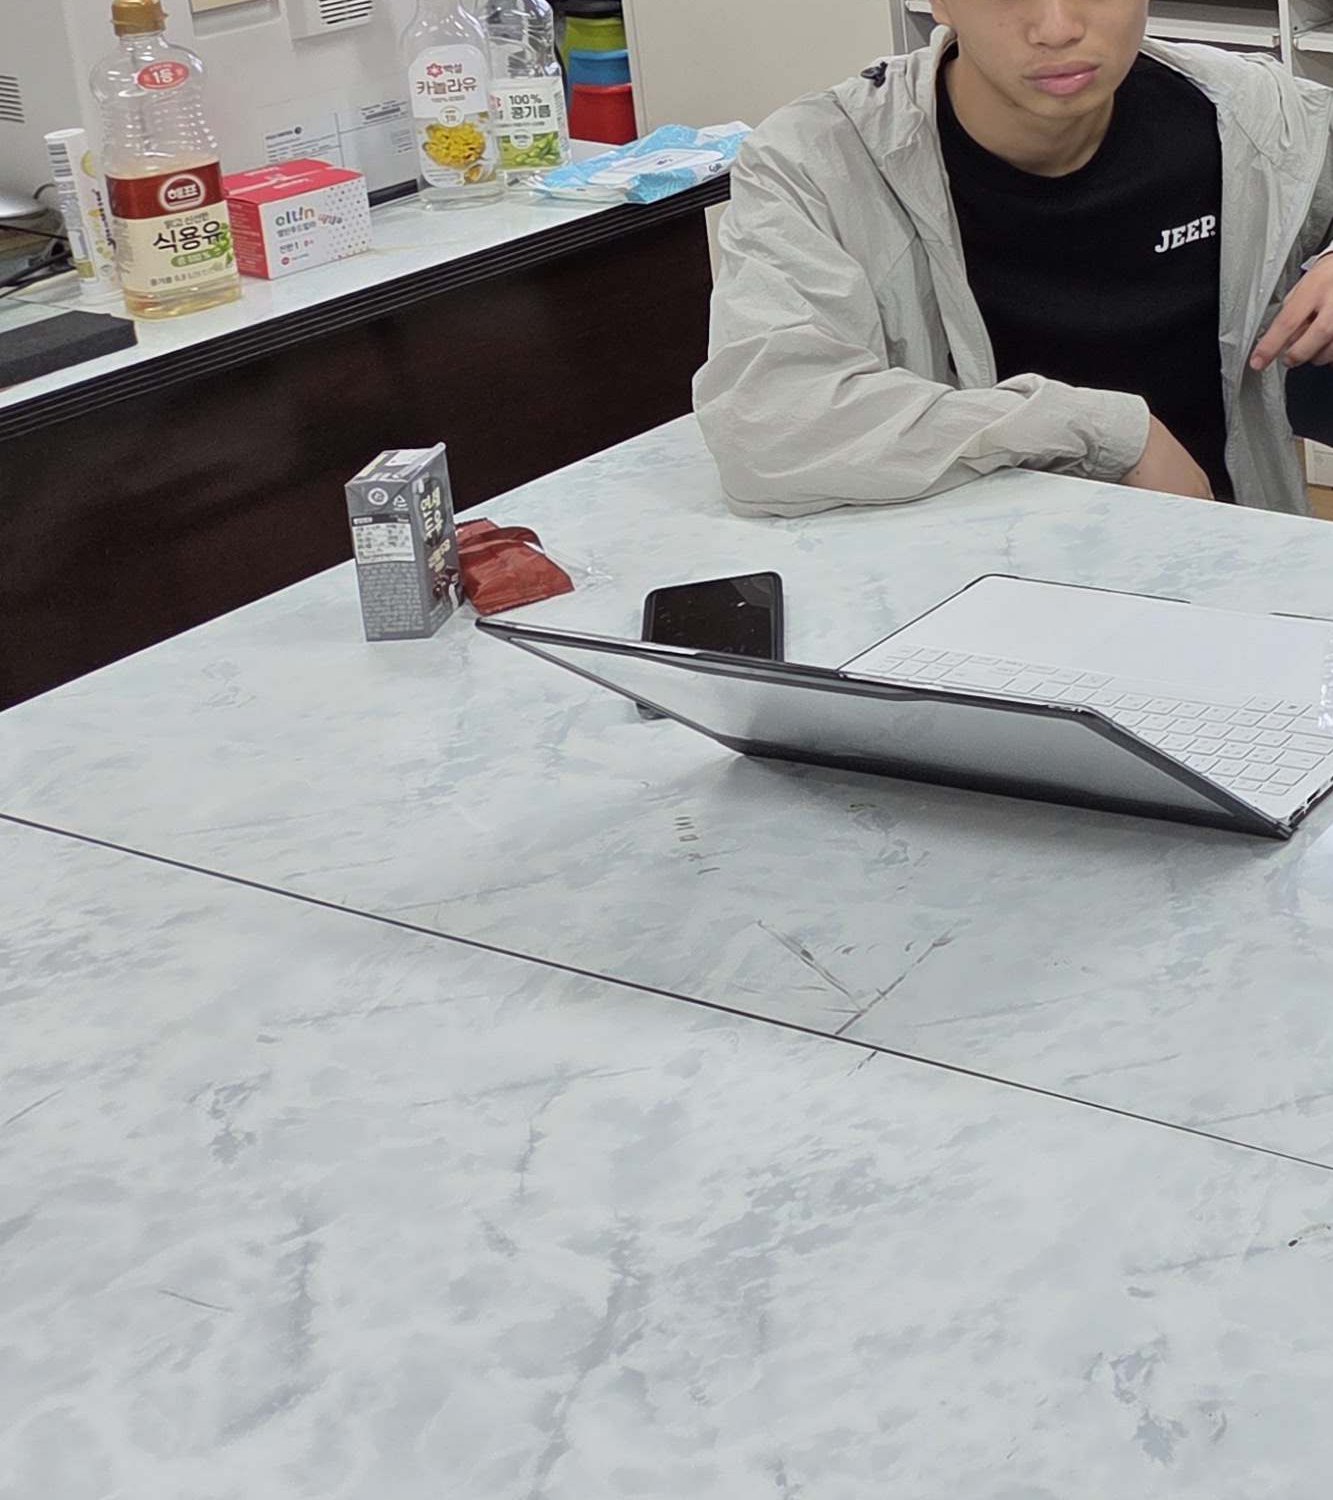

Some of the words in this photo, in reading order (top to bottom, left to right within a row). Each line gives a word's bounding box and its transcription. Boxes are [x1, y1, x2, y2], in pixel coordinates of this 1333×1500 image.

[416, 77, 478, 95] 카놀라유
[511, 104, 551, 119] 콩기름
[152, 220, 225, 254] 식용유
[1154, 214, 1216, 253] JEEP
